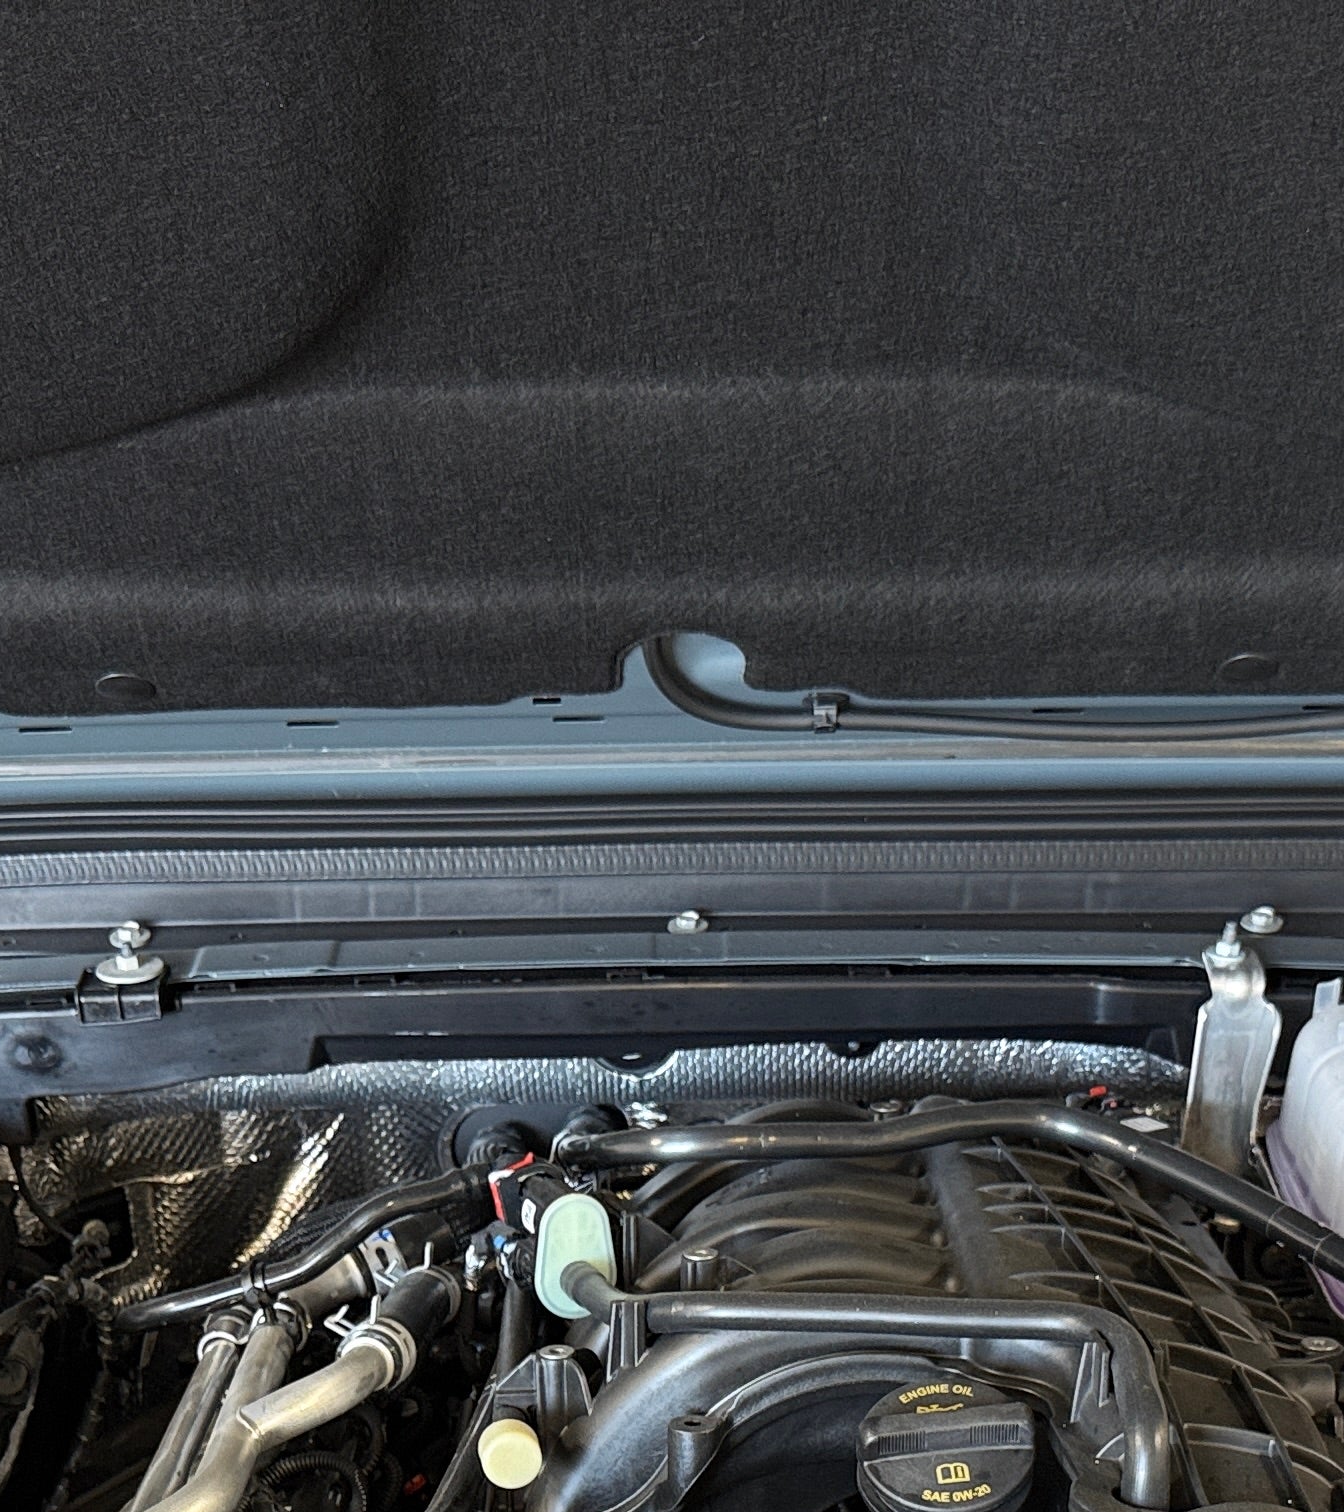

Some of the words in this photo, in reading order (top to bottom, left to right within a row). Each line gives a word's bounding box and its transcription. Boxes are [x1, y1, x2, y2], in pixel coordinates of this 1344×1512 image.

[898, 1383, 949, 1404] ENGINE
[951, 1384, 974, 1398] OIL
[921, 1489, 950, 1502] SAE
[952, 1483, 992, 1502] 0W-20
